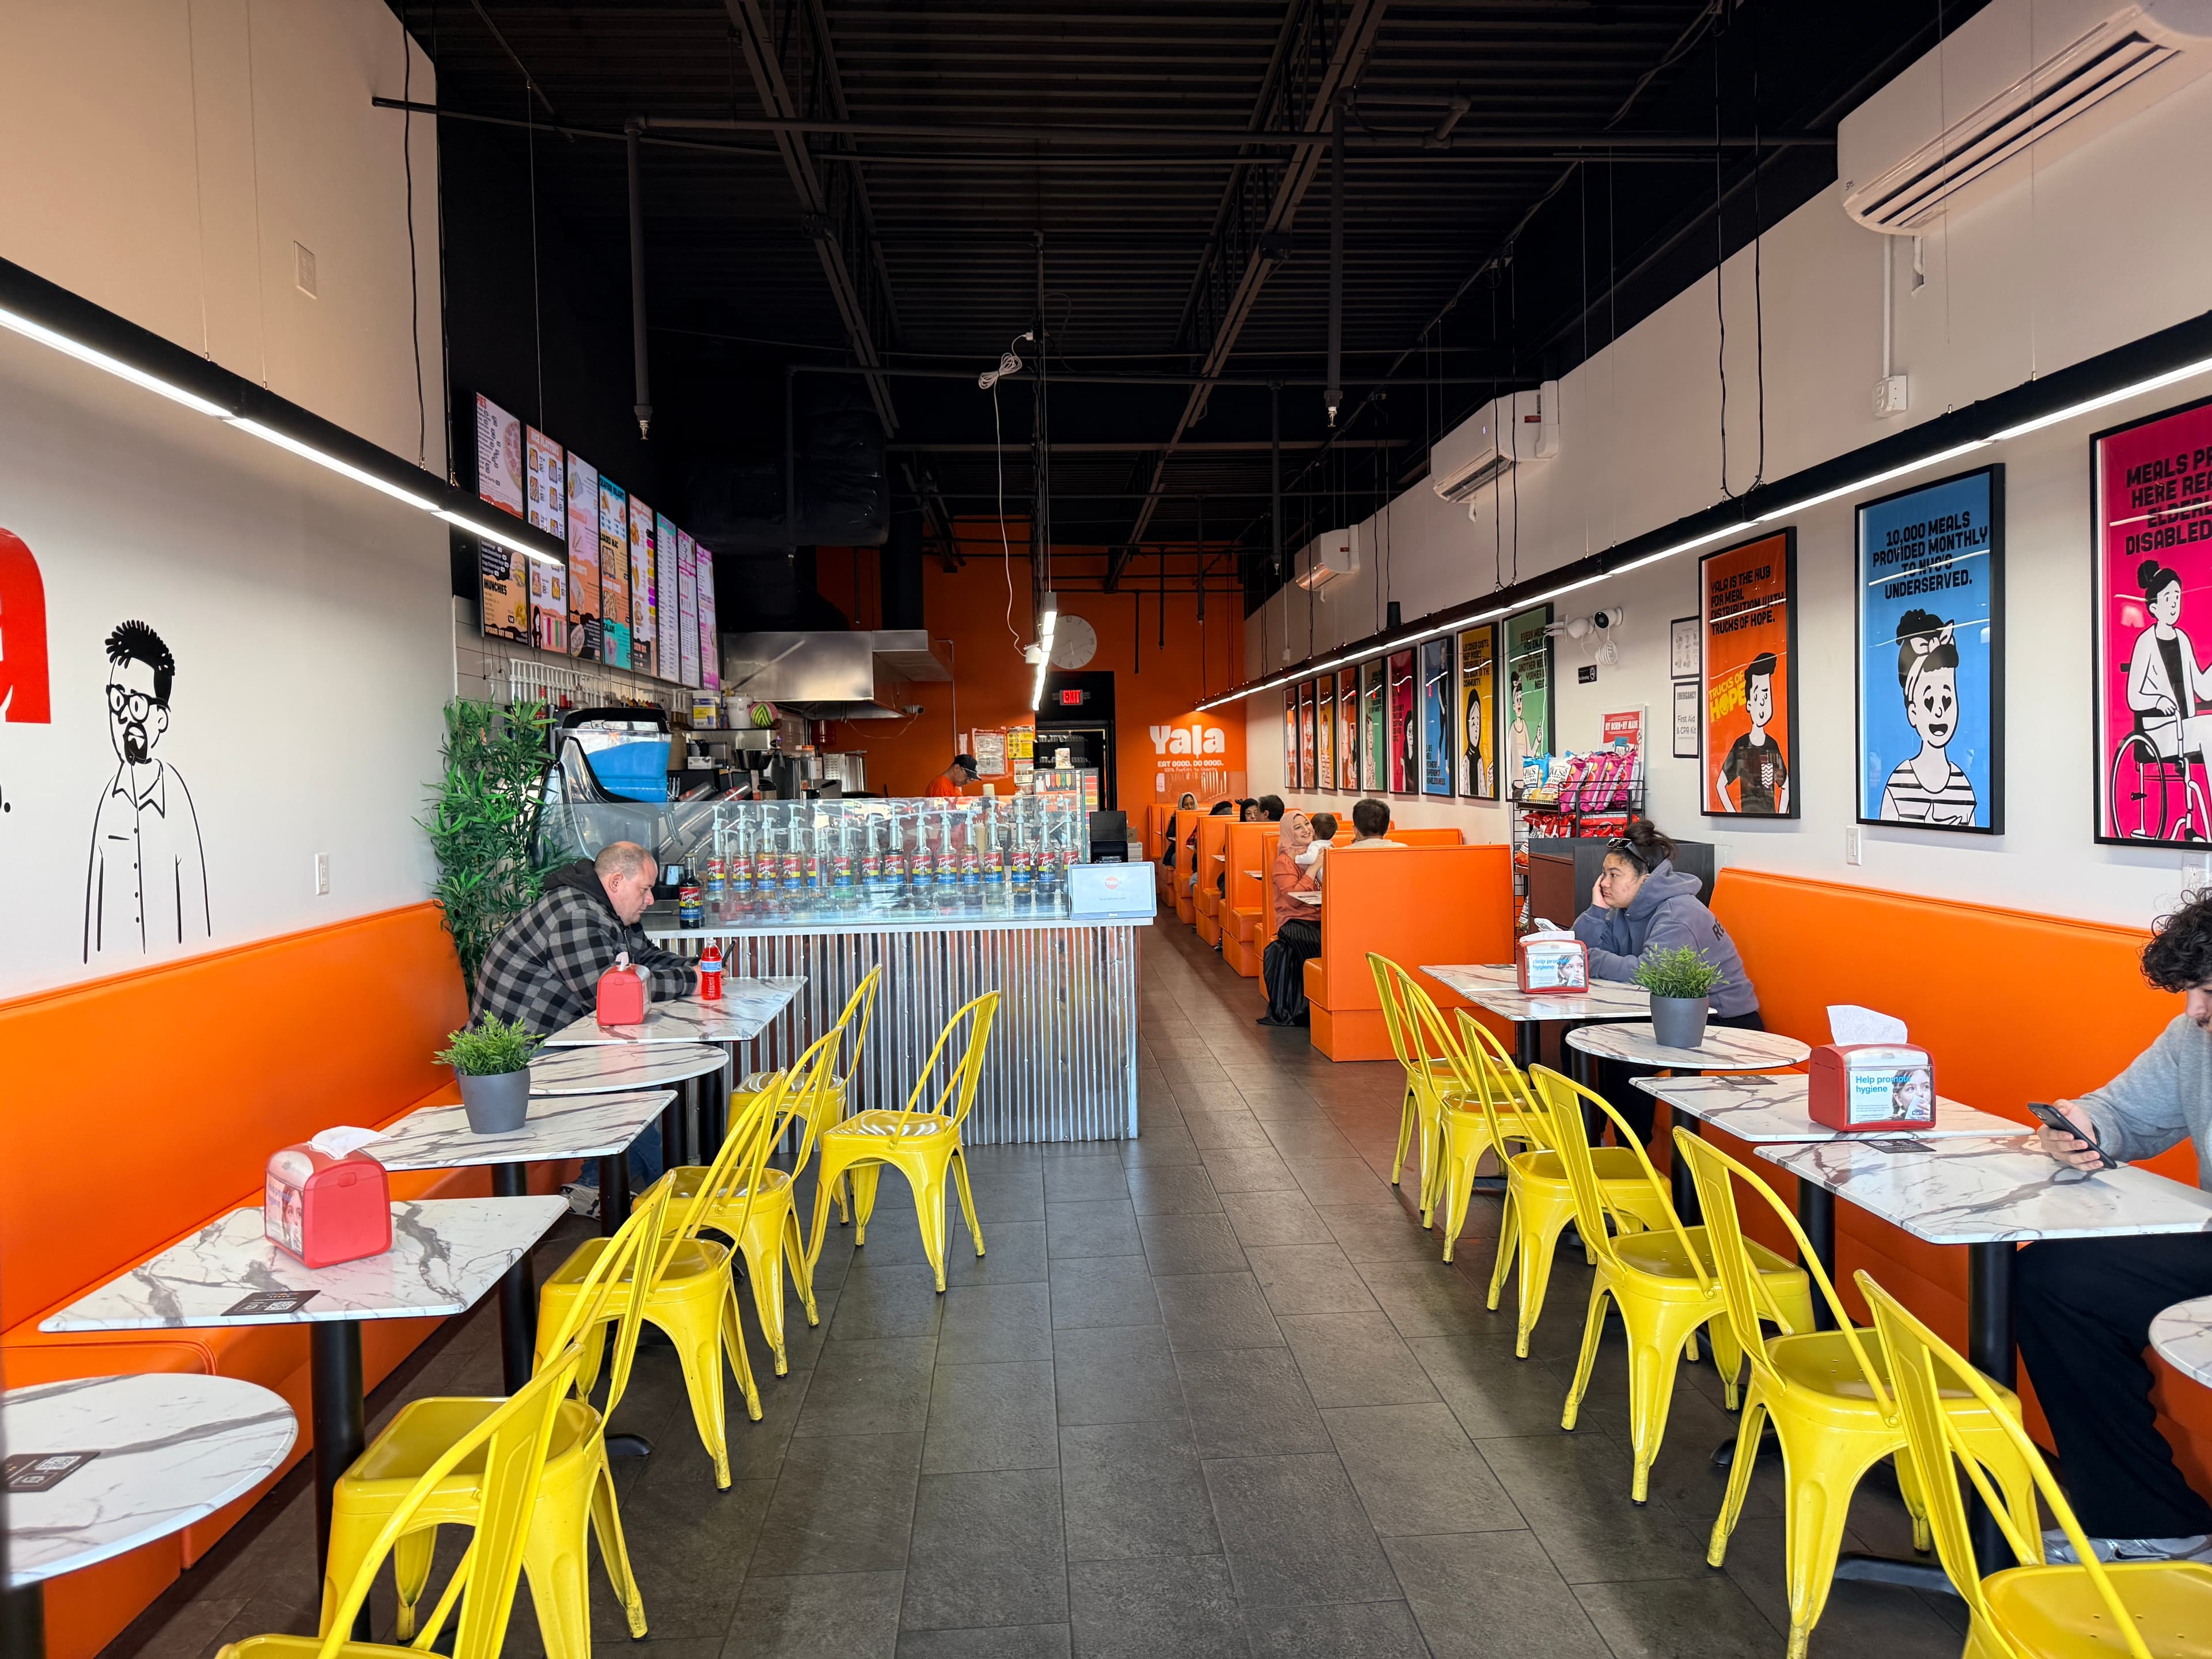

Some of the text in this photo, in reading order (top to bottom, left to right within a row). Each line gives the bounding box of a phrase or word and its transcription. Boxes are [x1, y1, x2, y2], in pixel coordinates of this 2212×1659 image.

[2127, 453, 2188, 488] MEALS
[2132, 479, 2177, 509] HERE
[1886, 511, 1970, 547] 10,000 MEALS
[1873, 526, 1987, 567] PROVIDED MONTHLY
[1902, 562, 1916, 578] TO
[1711, 565, 1771, 594] YALA IS THE HUB
[1885, 569, 1972, 599] UNDERSERVED.
[484, 578, 507, 596] MUNCHIES
[1711, 588, 1744, 608] FOR MEAL
[1711, 610, 1775, 636] TRUCKS OF HOPE.
[1709, 670, 1744, 700] TRUCKS OF
[1063, 690, 1081, 704] EXIT
[1710, 681, 1747, 724] HOPE
[1605, 722, 1611, 730] NY
[1628, 720, 1638, 729] MADE
[1677, 715, 1687, 723] First
[1680, 726, 1690, 734] CPR
[1149, 725, 1225, 759] Yala
[733, 863, 750, 873] Torani
[757, 863, 775, 872] Torani
[884, 857, 902, 868] Torani
[914, 858, 931, 869] Torani
[937, 857, 955, 868] Torani
[961, 857, 978, 868] Torani
[1012, 856, 1029, 866] Torani
[680, 891, 699, 902] Torani
[1856, 1075, 1911, 1084] Help promote
[1856, 1085, 1888, 1094] hygiene
